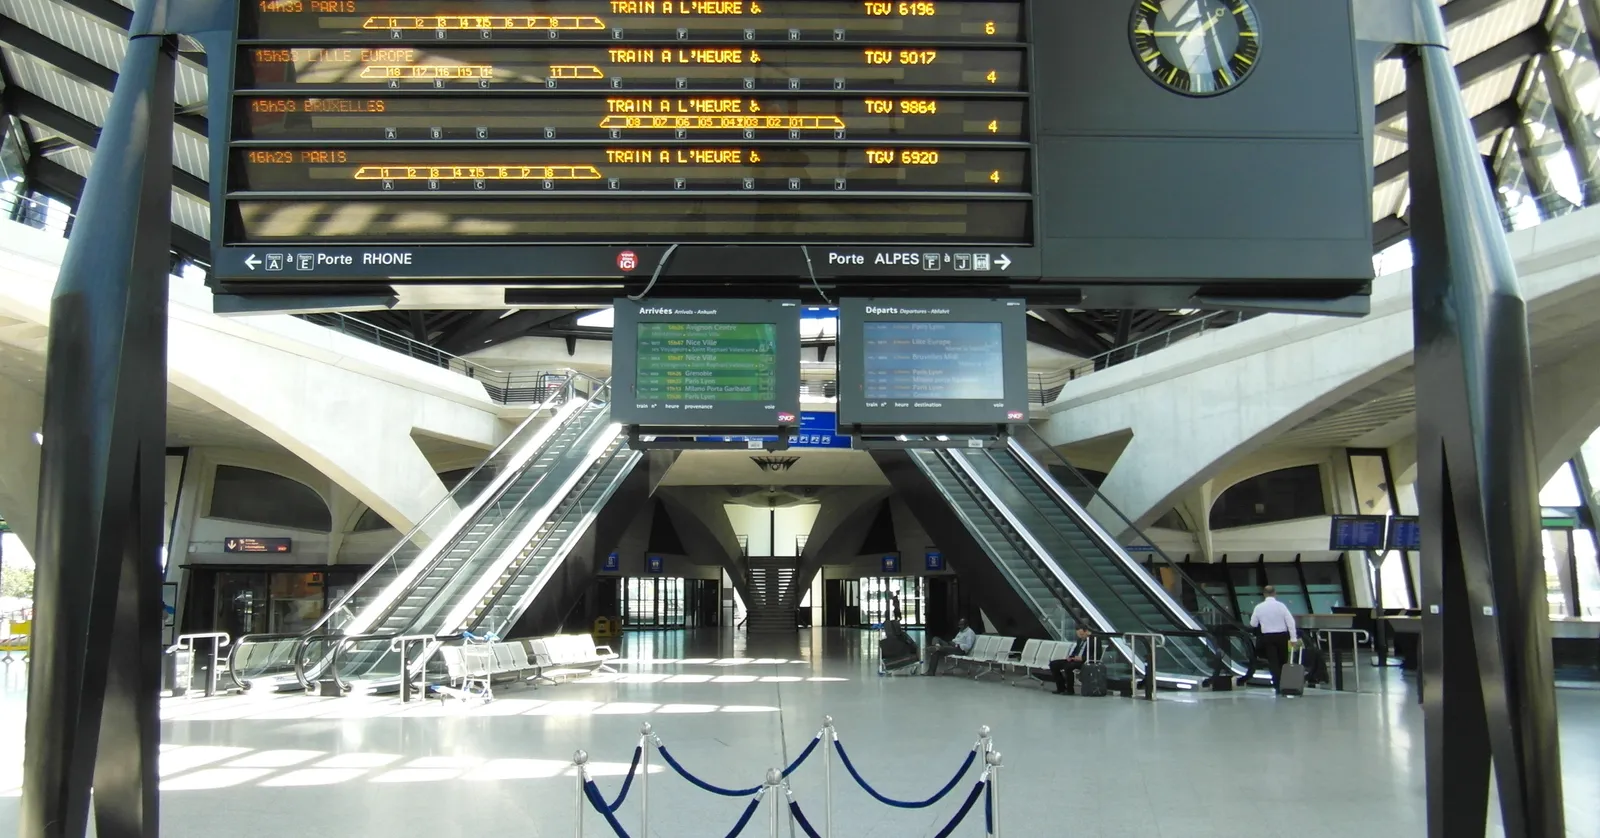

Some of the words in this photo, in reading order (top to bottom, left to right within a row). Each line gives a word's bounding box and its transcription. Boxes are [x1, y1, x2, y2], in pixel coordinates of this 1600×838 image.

[311, 1, 356, 12] PARIS
[610, 2, 655, 14] TRAIN
[662, 2, 672, 14] A
[680, 2, 742, 14] L'HEURE
[864, 2, 891, 16] TGV
[899, 2, 935, 16] 6196
[986, 22, 995, 34] 6
[256, 50, 299, 62] 15h53
[308, 50, 352, 62] LILLE
[360, 50, 414, 62] EUROPE
[608, 50, 654, 63] TRAIN
[662, 50, 672, 63] A
[679, 50, 742, 63] L'HEURE
[864, 51, 892, 64] TGV
[900, 51, 937, 64] 5017
[986, 70, 996, 83] 4
[252, 100, 296, 112] 15h53
[304, 100, 385, 112] BRUXELLES
[607, 100, 652, 112] TRAIN
[660, 100, 671, 112] A
[678, 100, 741, 112] L'HEURE
[865, 100, 892, 113] TGV
[900, 101, 937, 114] 9864
[988, 120, 998, 133] 4
[249, 151, 293, 163] 16h29
[301, 151, 347, 163] PARIS
[606, 150, 652, 163] TRAIN
[660, 150, 670, 163] A
[678, 150, 741, 163] L'HEURE
[866, 151, 894, 164] TGV
[902, 151, 938, 164] 6920
[990, 171, 1000, 184] 4
[269, 261, 278, 269] A
[286, 254, 293, 263] à
[301, 261, 309, 269] E
[317, 253, 353, 265] Porte
[363, 253, 412, 264] RHONE
[620, 260, 635, 269] ICI
[829, 253, 865, 265] Porte
[874, 253, 920, 265] ALPES
[928, 260, 935, 269] F
[944, 254, 951, 263] à
[959, 260, 965, 269] J
[639, 307, 673, 315] Arrivées
[866, 306, 898, 315] Départs
